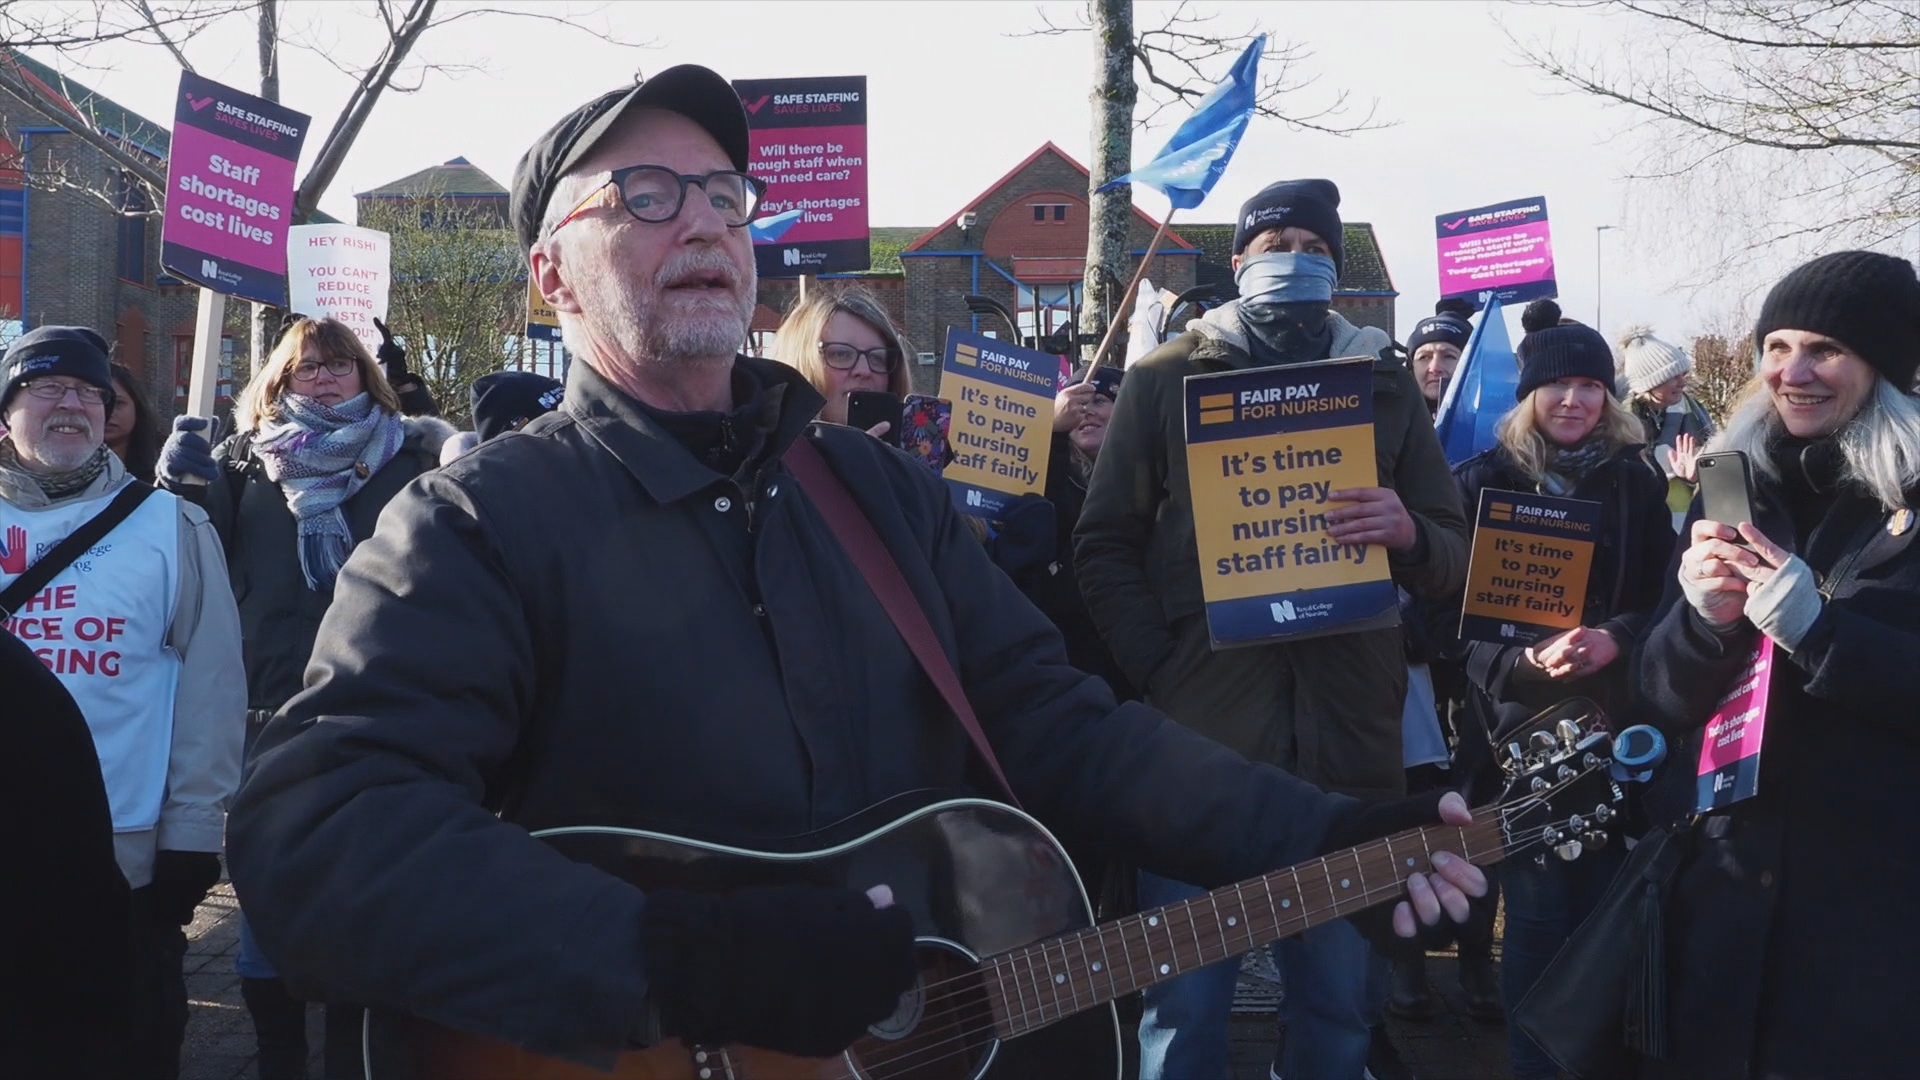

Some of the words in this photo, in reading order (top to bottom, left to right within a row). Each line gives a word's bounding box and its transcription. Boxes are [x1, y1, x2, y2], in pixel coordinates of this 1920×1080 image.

[774, 94, 803, 104] SAFE
[805, 92, 859, 103] STAFFING
[774, 104, 808, 114] SAVES
[812, 104, 842, 112] LIVES
[214, 111, 248, 131] SAVES
[251, 124, 279, 141] LIVES
[216, 101, 246, 120] SAFE
[245, 112, 298, 138] STAFFING
[760, 145, 785, 157] Will
[789, 144, 824, 155] there
[827, 142, 843, 154] be
[208, 154, 261, 186] Staff
[749, 159, 790, 172] nough
[794, 156, 823, 169] staff
[827, 156, 862, 167] when
[781, 171, 812, 182] need
[816, 170, 850, 181] care?
[179, 175, 280, 220] shortages
[760, 200, 793, 213] day's
[797, 198, 860, 211] shortages
[180, 204, 224, 231] cost
[228, 214, 274, 245] lives
[804, 212, 833, 222] lives
[1468, 213, 1493, 223] SAFE
[1494, 205, 1540, 218] STAFFING
[1469, 218, 1498, 228] SAVES
[1500, 214, 1527, 222] LIVES
[309, 237, 337, 247] HEY
[1444, 247, 1485, 257] enough
[1486, 242, 1512, 252] staff
[1513, 236, 1544, 247] when
[1459, 240, 1481, 249] Will
[1483, 234, 1512, 245] there
[1455, 254, 1475, 264] you
[1477, 250, 1504, 259] need
[1505, 244, 1534, 255] care?
[308, 267, 336, 277] YOU
[342, 267, 378, 281] CAN'T
[1447, 265, 1489, 276] Today's
[1490, 258, 1545, 270] shortages
[1470, 271, 1494, 280] cost
[1496, 267, 1522, 276] lives
[318, 282, 370, 294] REDUCE
[316, 296, 373, 310] WAITING
[981, 350, 1006, 365] FAIR
[1008, 358, 1030, 371] PAY
[980, 362, 1002, 374] FOR
[1004, 367, 1052, 387] NURSING
[960, 386, 988, 406] It's
[994, 395, 1036, 418] time
[1240, 387, 1282, 405] FAIR
[1285, 383, 1320, 400] PAY
[1241, 404, 1275, 420] FOR
[1281, 395, 1360, 416] NURSING
[967, 410, 986, 426] to
[991, 418, 1025, 440] pay
[957, 430, 1029, 462] nursing
[953, 450, 987, 470] taff
[991, 458, 1039, 485] fairly
[1222, 452, 1266, 477] It's
[1273, 445, 1342, 470] time
[1238, 486, 1271, 508] to
[1278, 480, 1332, 508] pay
[1514, 514, 1538, 525] FOR
[1540, 518, 1590, 532] NURSING
[1516, 505, 1542, 517] FAIR
[1544, 509, 1568, 520] PAY
[1232, 509, 1330, 540] nursin
[1216, 545, 1286, 576] staff
[1292, 537, 1368, 566] fairly
[1496, 538, 1523, 554] It's
[1530, 542, 1574, 560] time
[1502, 558, 1520, 571] to
[1526, 562, 1561, 580] pay
[1491, 576, 1565, 598] nursing
[26, 585, 76, 612] HE
[1476, 591, 1520, 608] staff
[1526, 596, 1575, 617] fairly
[2, 617, 63, 640] ICE
[74, 617, 126, 642] OF
[34, 648, 121, 677] SING
[1717, 734, 1730, 748] cost
[1730, 728, 1745, 743] lives
